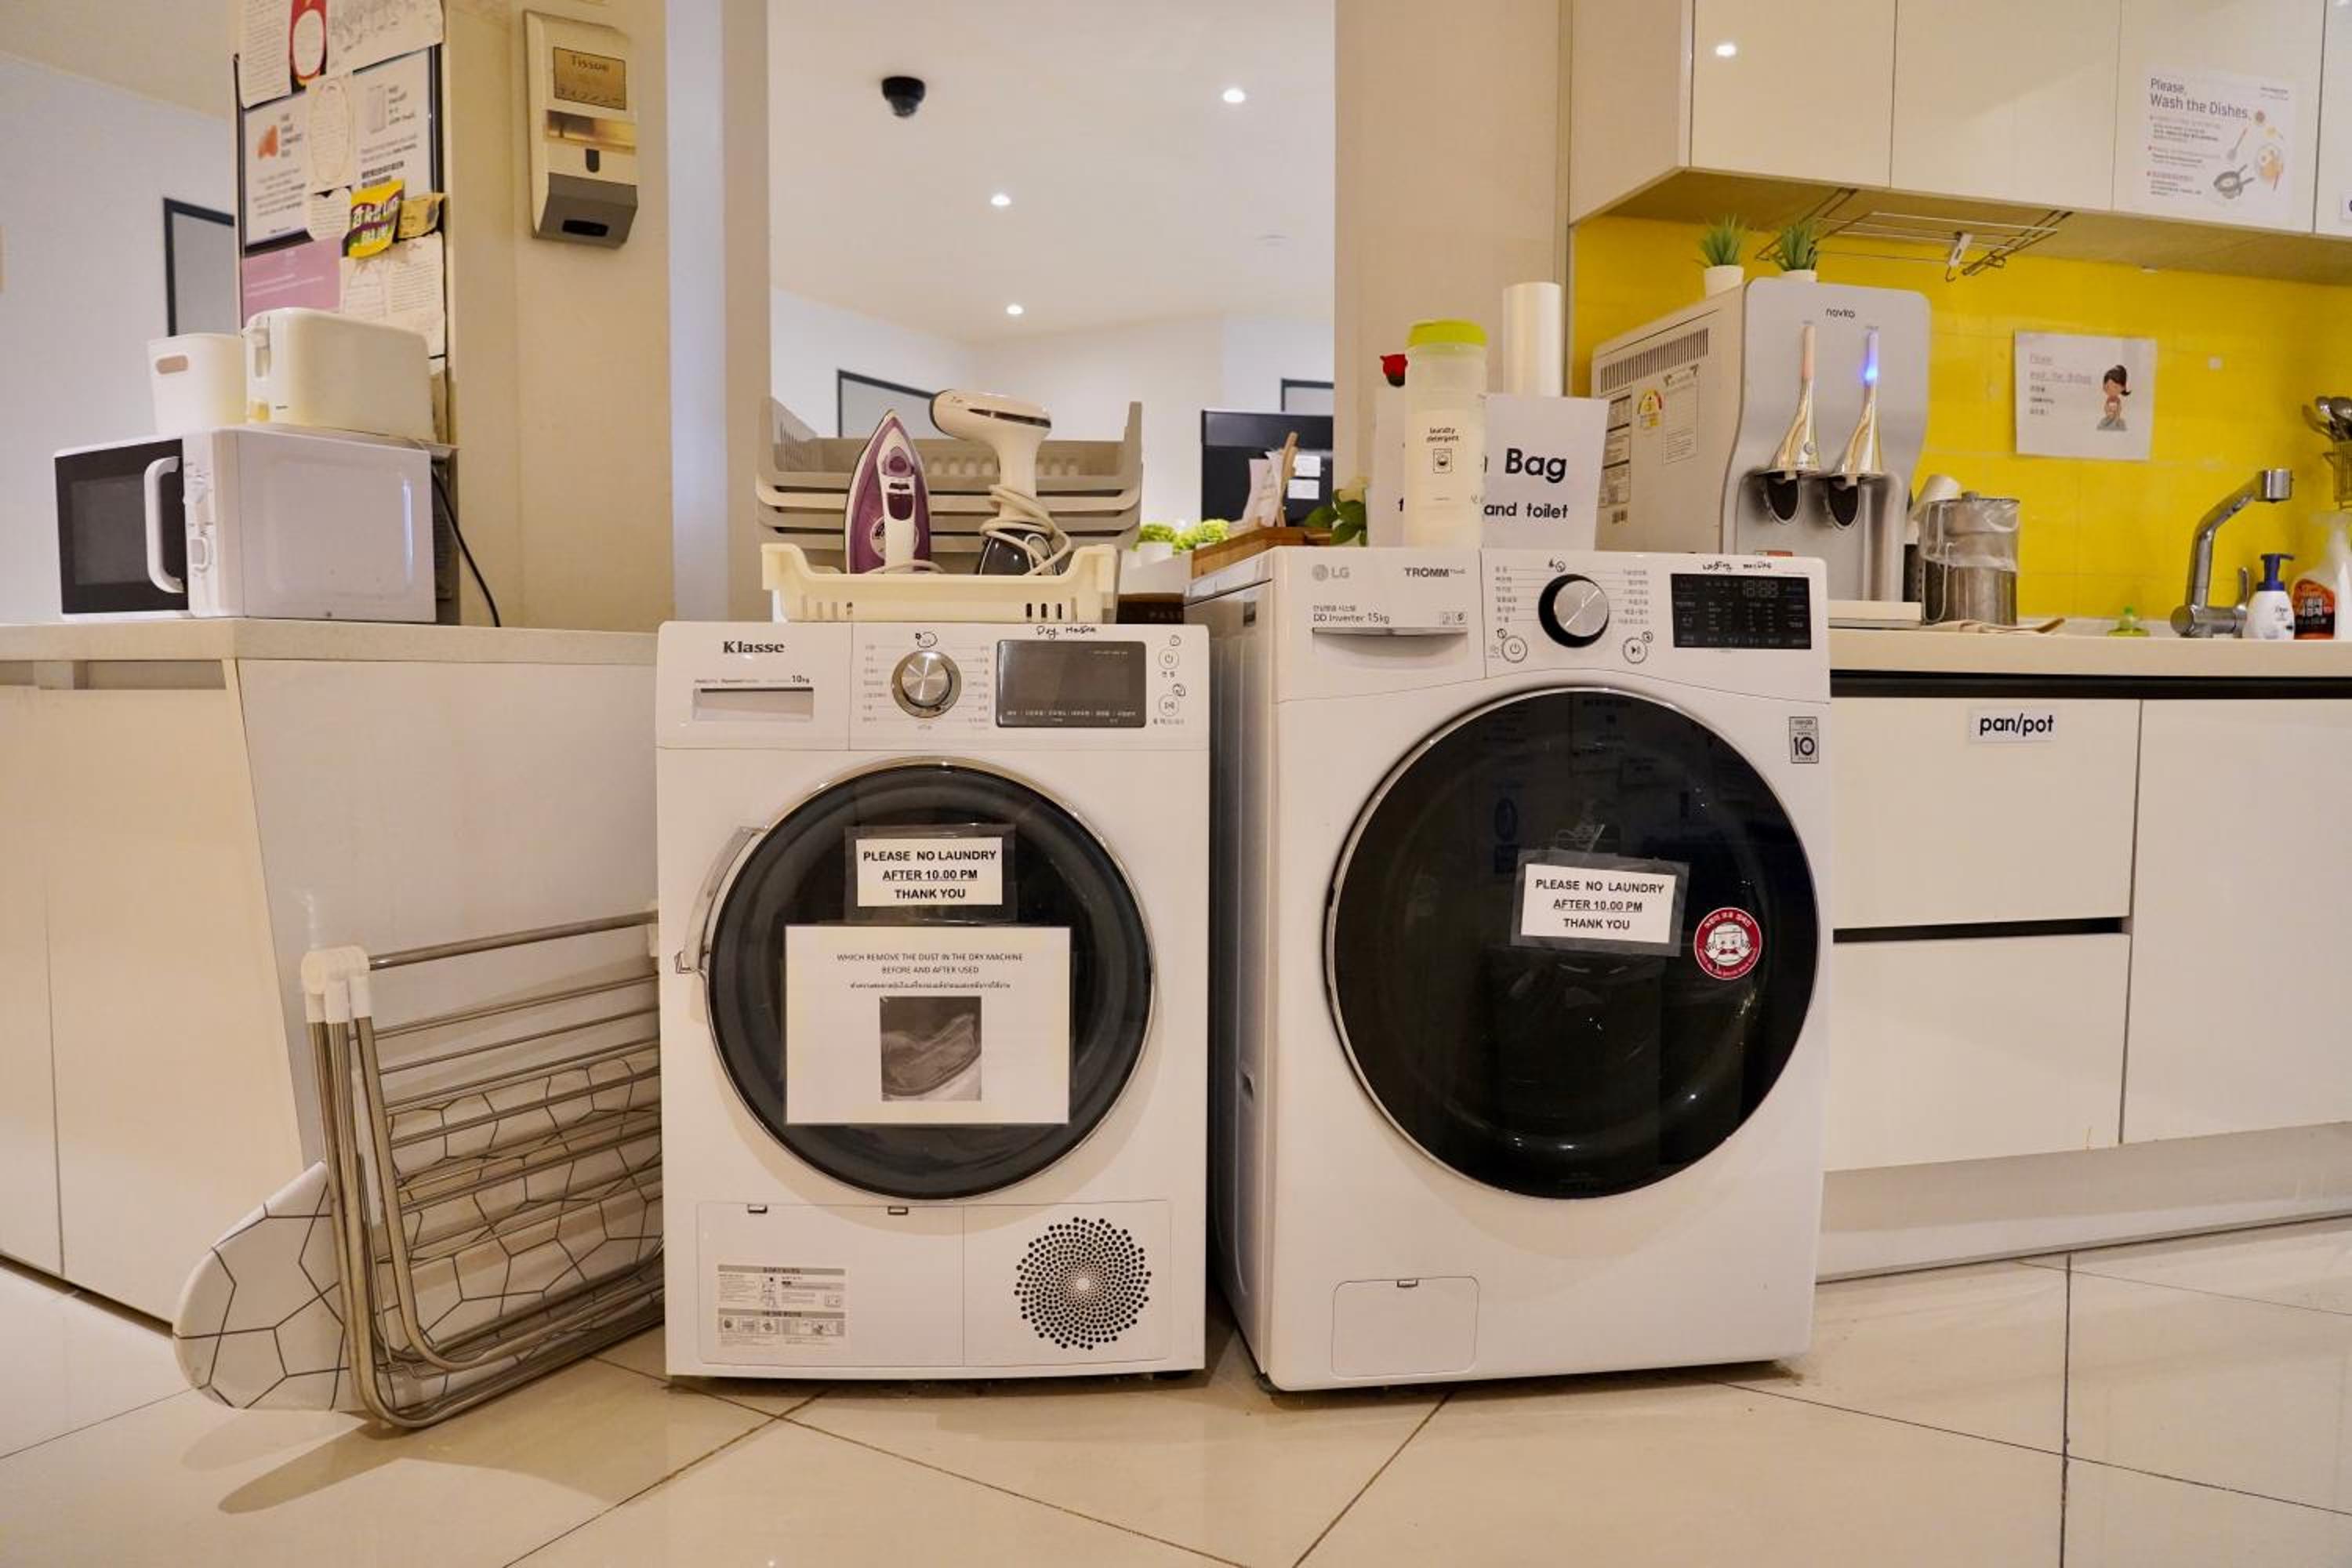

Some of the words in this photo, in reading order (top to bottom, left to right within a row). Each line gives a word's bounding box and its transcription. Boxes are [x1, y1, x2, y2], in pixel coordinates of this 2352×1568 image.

[2151, 93, 2183, 110] Wash
[2187, 99, 2207, 113] the
[1429, 426, 1456, 435] laundry
[1504, 448, 1567, 483] Bag
[1483, 503, 1517, 517] and
[1526, 503, 1568, 518] toilet
[1332, 567, 1350, 578] LG
[1404, 567, 1450, 578] TROMM
[1313, 613, 1328, 622] DD
[1329, 613, 1365, 622] Inverter
[1368, 612, 1390, 624] 15kg
[723, 641, 786, 653] Klasse
[1980, 713, 2054, 736] pan/pot
[1794, 737, 1815, 756] 10
[863, 851, 911, 861] PLEASE
[916, 851, 935, 861] NO
[938, 851, 996, 861] LAUNDRY
[882, 869, 922, 880] AFTER
[926, 869, 957, 880] 10.00
[960, 869, 978, 880] PM
[1536, 879, 1580, 890] PLEASE
[1586, 880, 1602, 891] NO
[1608, 883, 1664, 894] LAUNDRY
[895, 889, 936, 898] THANK
[940, 888, 966, 898] YOU
[1553, 898, 1591, 910] AFTER
[1595, 901, 1623, 910] 10.00
[1625, 902, 1642, 912] PM
[1563, 918, 1603, 928] THANK
[1606, 919, 1630, 929] YOU
[837, 953, 864, 961] WHICH
[866, 953, 899, 961] REMOVE
[902, 953, 916, 961] THE
[918, 953, 939, 961] DUST
[952, 953, 965, 961] THE
[968, 953, 985, 961] DRY
[985, 953, 1022, 961] MACHINE
